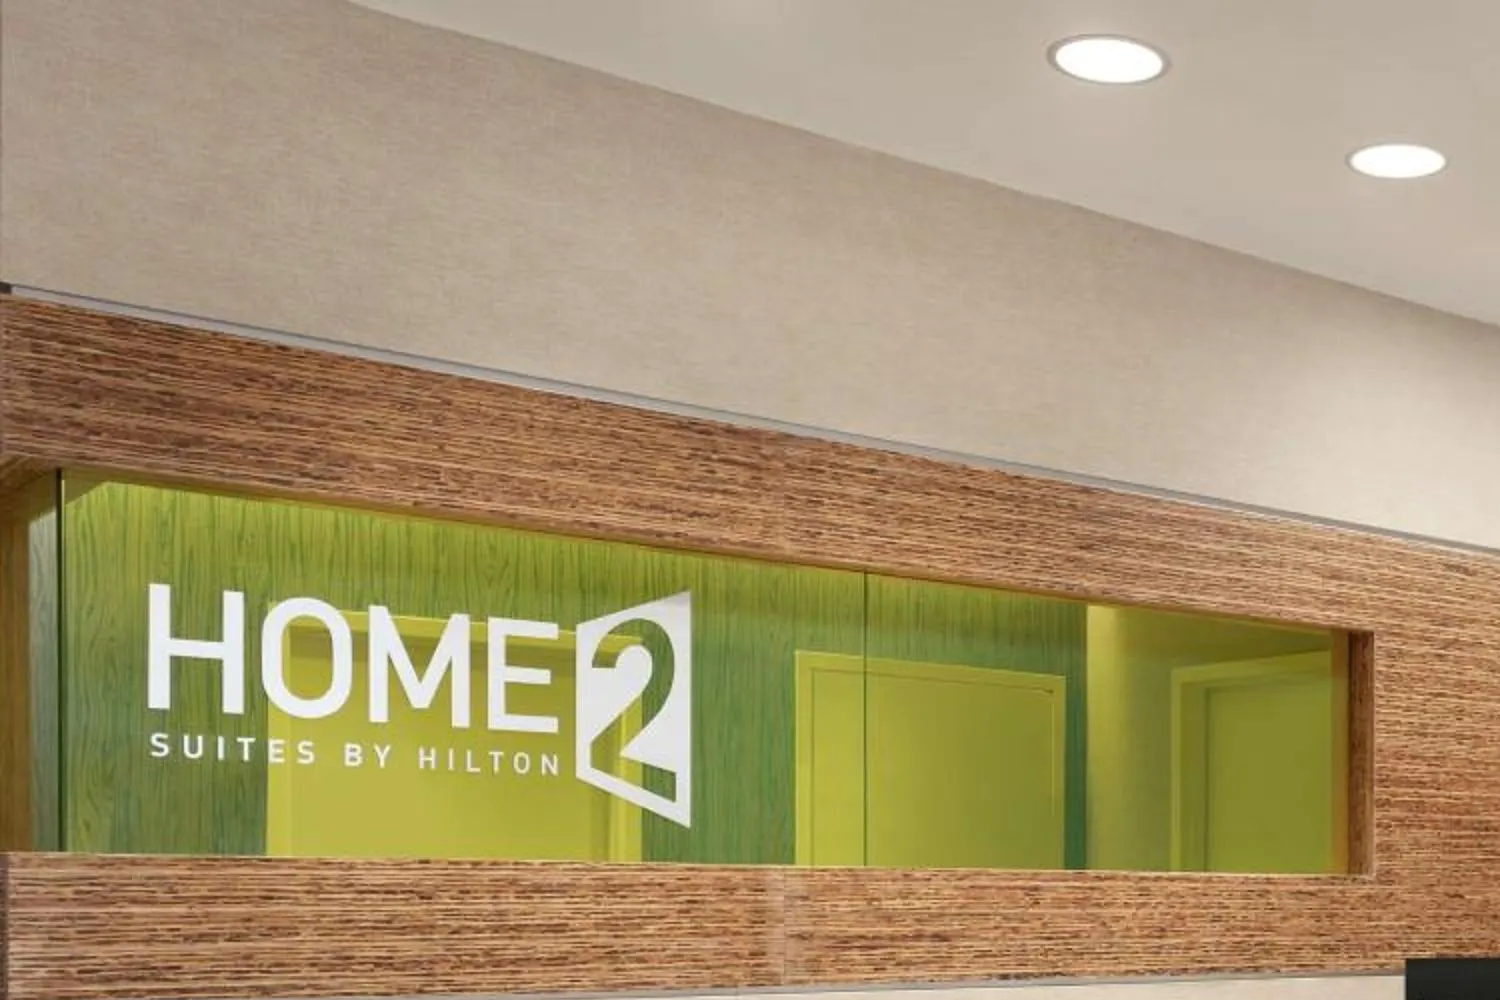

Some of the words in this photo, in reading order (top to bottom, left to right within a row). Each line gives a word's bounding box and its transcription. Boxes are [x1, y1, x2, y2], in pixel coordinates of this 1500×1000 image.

[150, 733, 316, 765] SUITES
[344, 743, 391, 769] BY
[418, 748, 559, 776] HILTON
